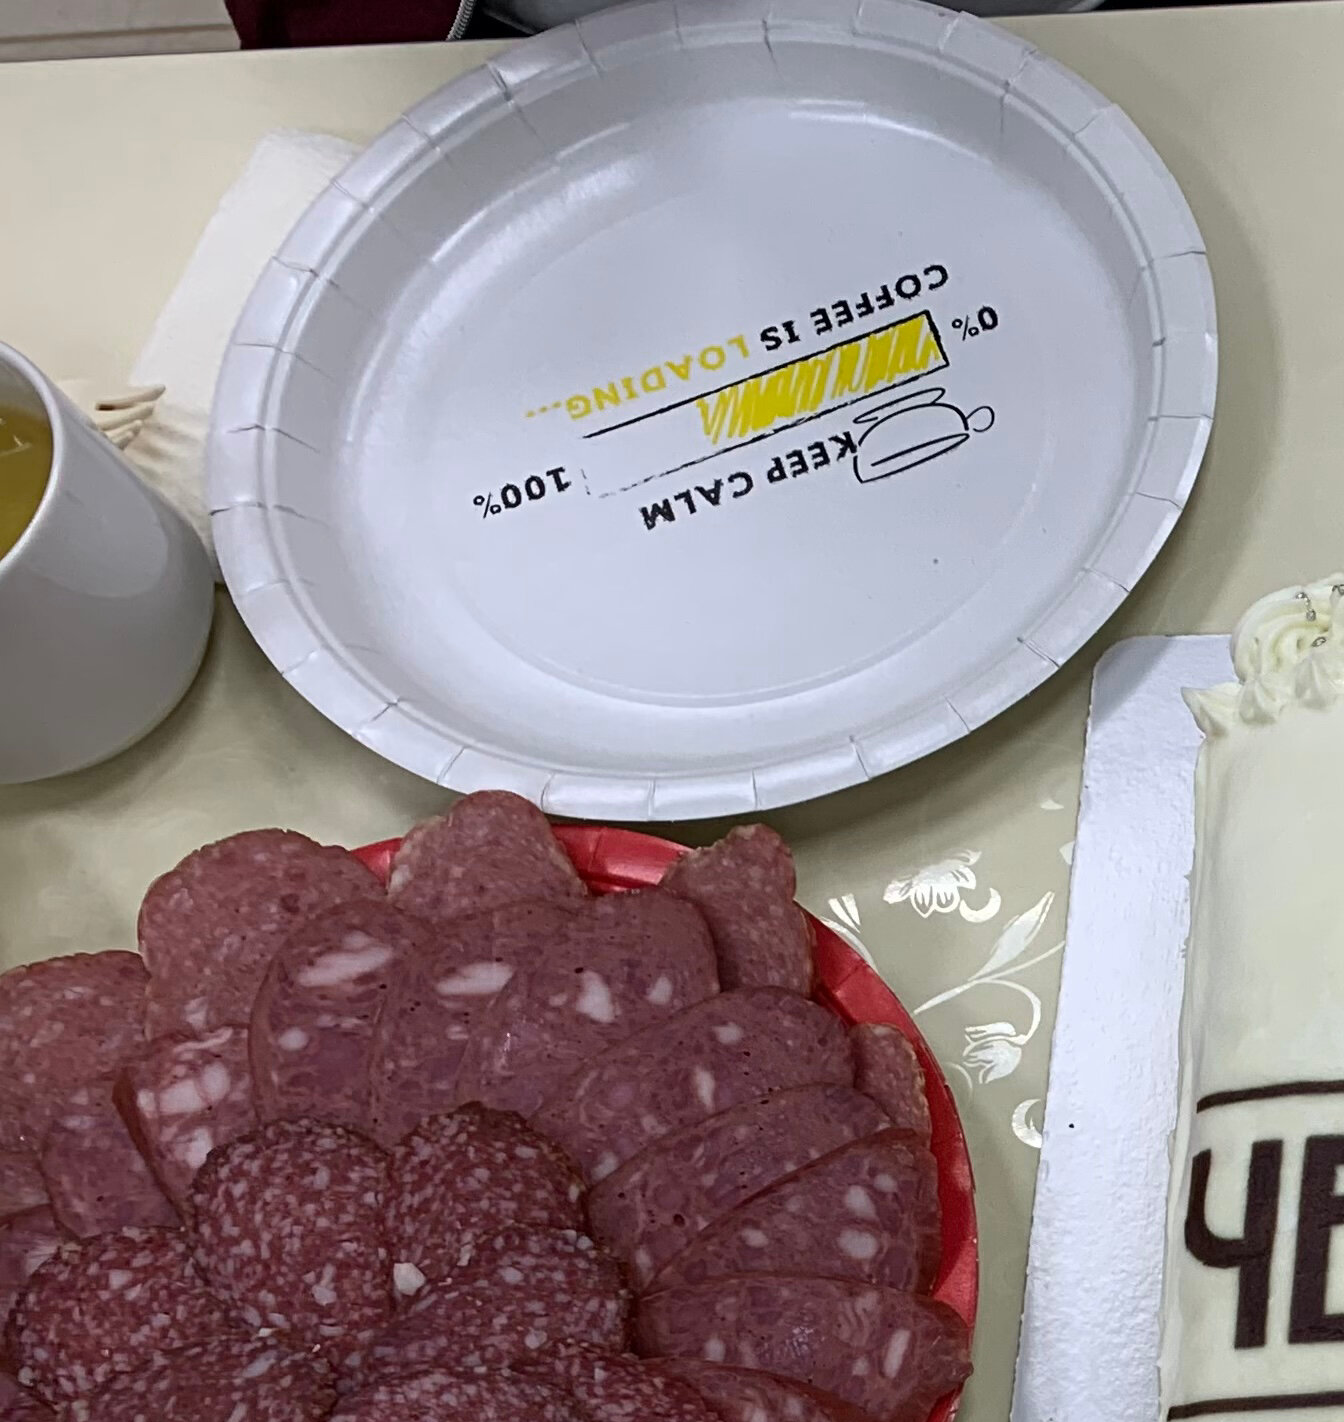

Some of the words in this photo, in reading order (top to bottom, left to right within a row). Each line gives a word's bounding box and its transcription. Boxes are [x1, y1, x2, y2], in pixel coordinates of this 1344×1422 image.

[810, 264, 949, 336] COFFEE
[952, 306, 998, 342] 0%
[760, 319, 800, 351] IS
[766, 430, 858, 485] KEEP
[473, 466, 572, 519] 100%
[640, 470, 753, 531] CALM
